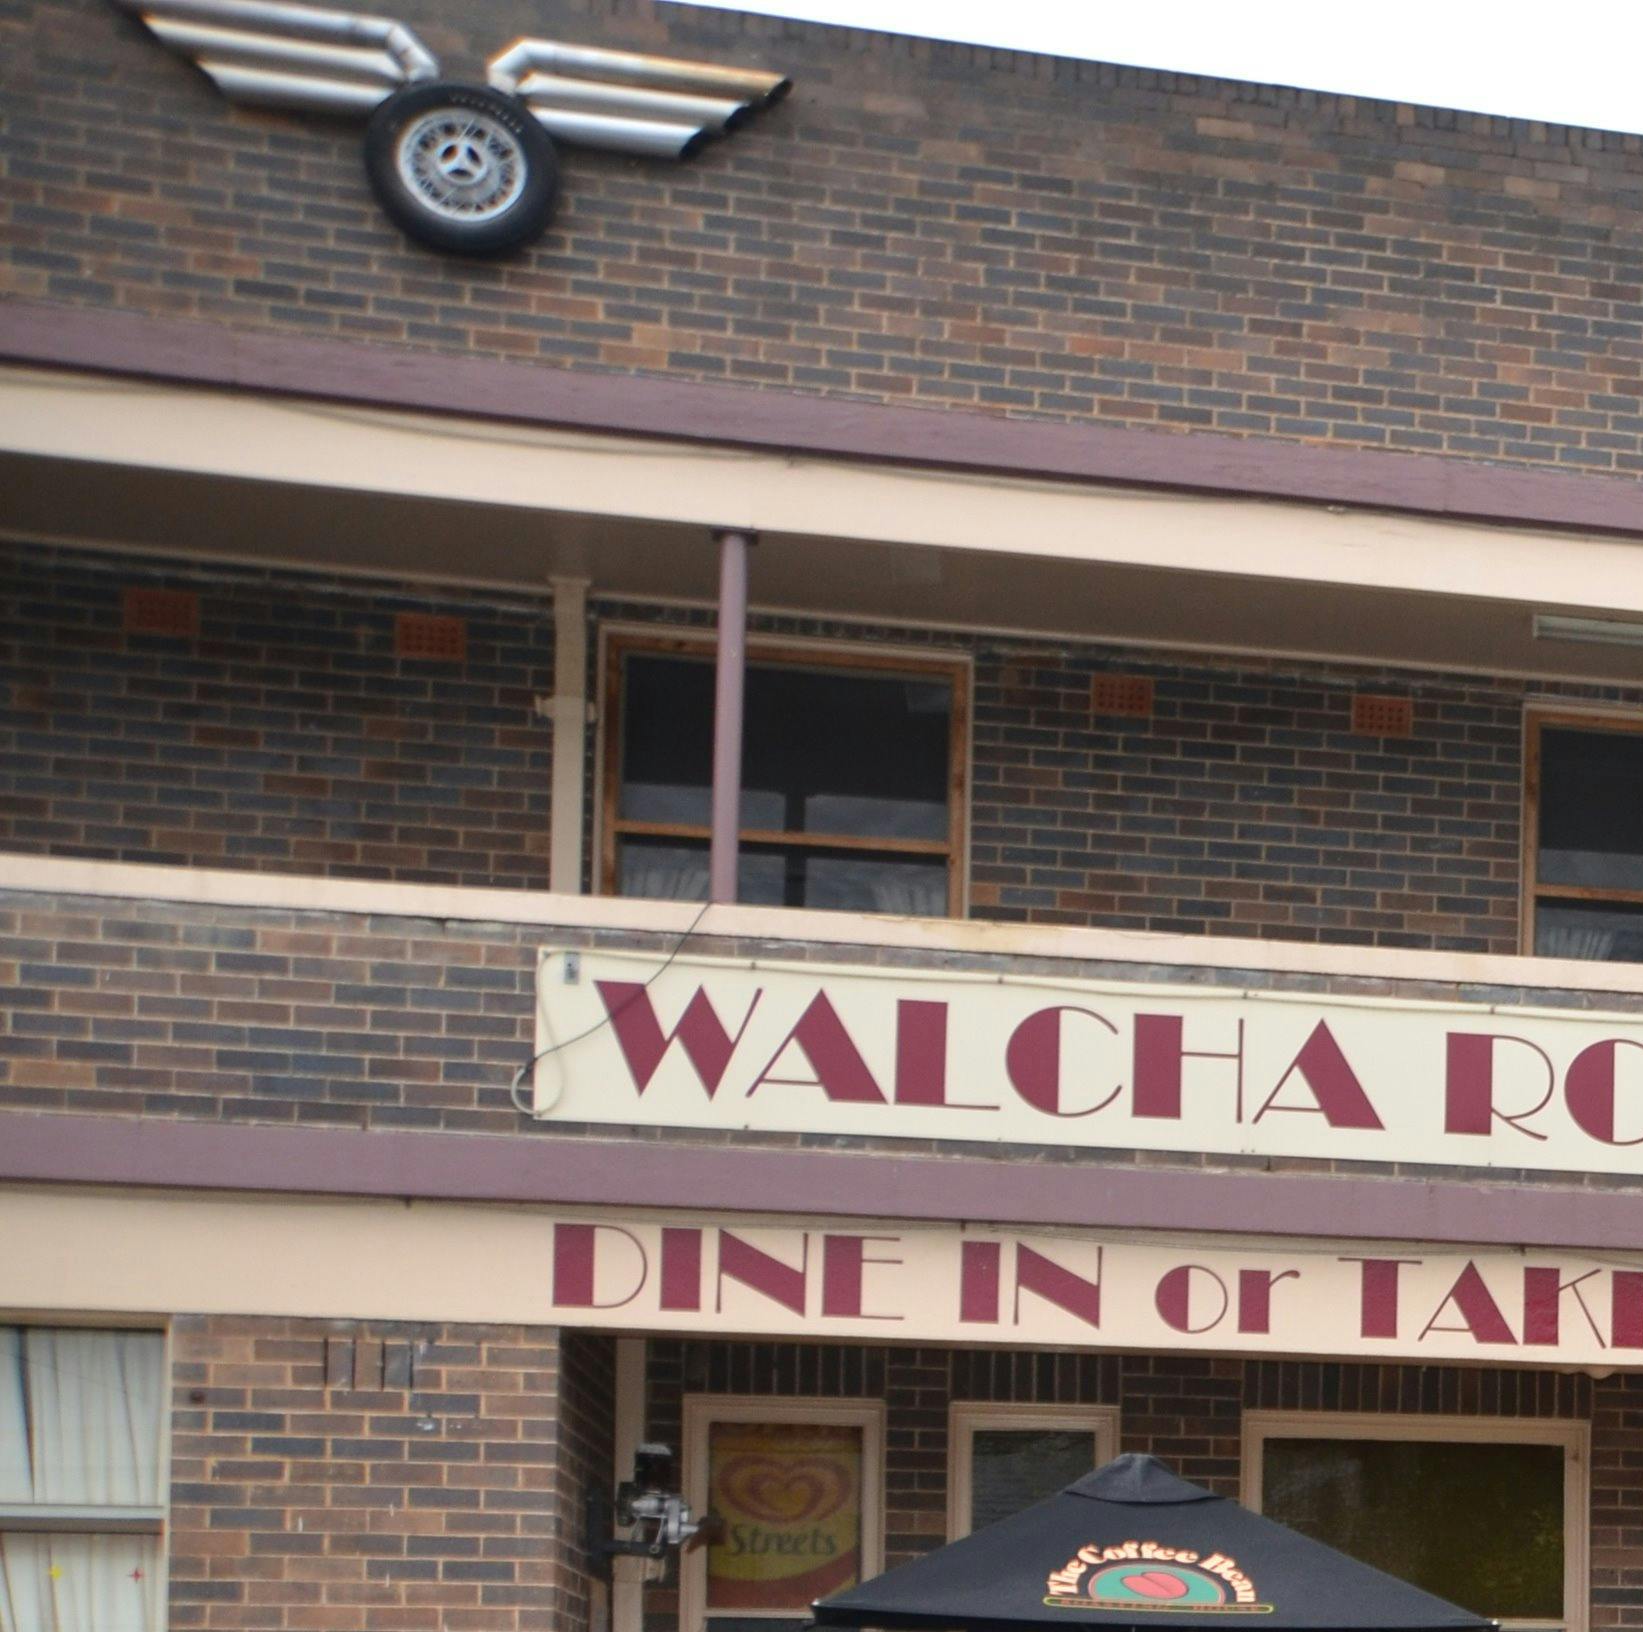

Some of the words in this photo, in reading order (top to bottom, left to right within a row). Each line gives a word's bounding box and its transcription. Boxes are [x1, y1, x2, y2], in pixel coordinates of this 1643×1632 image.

[593, 979, 1386, 1131] WALCHA
[551, 1222, 906, 1321] DINE
[958, 1240, 1104, 1330] IN
[1154, 1263, 1302, 1335] or
[732, 1523, 838, 1557] Streets
[1047, 1557, 1088, 1596] The
[1077, 1539, 1200, 1565] Coffee
[1198, 1551, 1257, 1603] Bean
